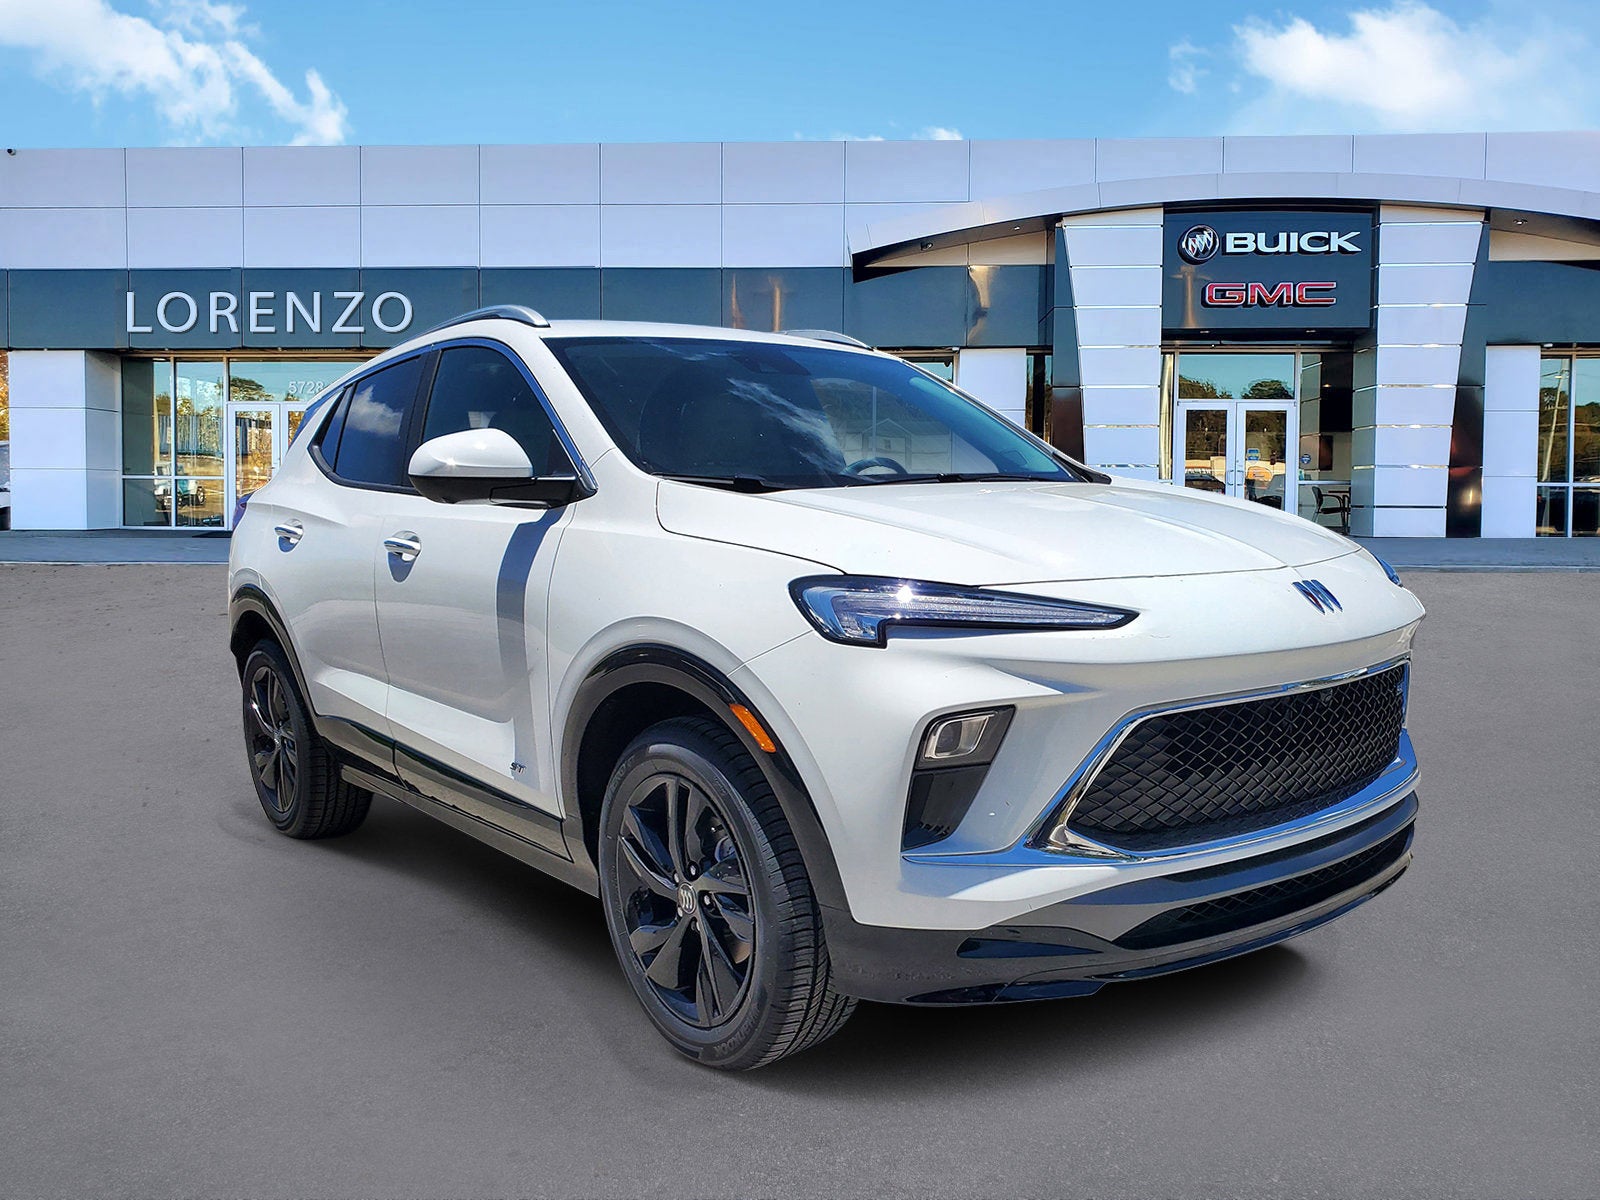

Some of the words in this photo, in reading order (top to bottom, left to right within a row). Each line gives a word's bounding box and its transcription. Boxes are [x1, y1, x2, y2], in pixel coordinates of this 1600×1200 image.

[1225, 231, 1362, 253] BUICK
[1204, 281, 1337, 306] GMC
[126, 290, 414, 334] LORENZO
[288, 380, 325, 395] 5728
